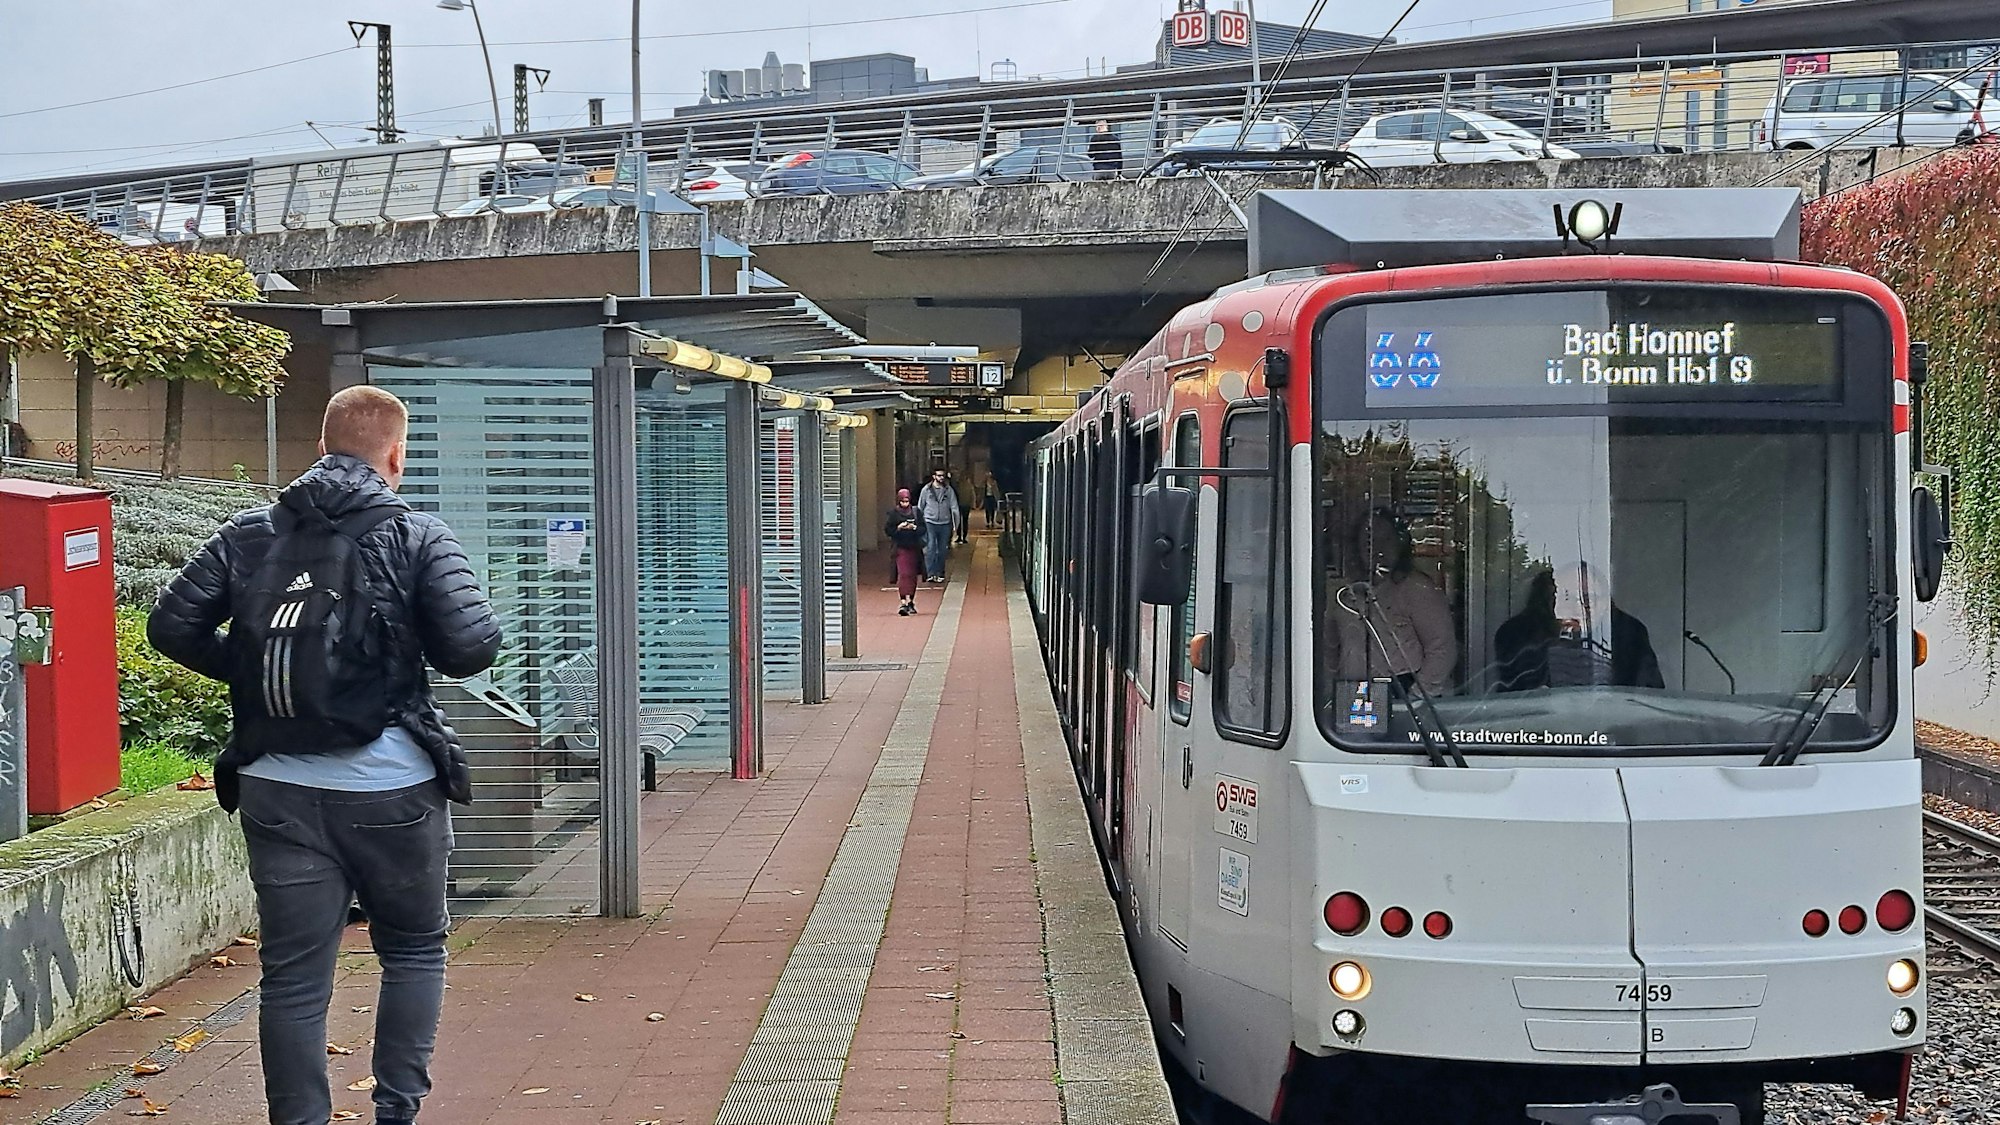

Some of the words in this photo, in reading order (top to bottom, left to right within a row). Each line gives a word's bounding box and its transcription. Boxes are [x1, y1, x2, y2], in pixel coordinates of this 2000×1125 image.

[1177, 16, 1203, 40] DB
[1223, 16, 1245, 40] DB
[1563, 323, 1620, 355] Bad
[1628, 323, 1735, 355] Honnef
[1370, 332, 1440, 388] 66
[1546, 359, 1572, 384] ü.
[1582, 357, 1657, 384] Bonn
[1667, 356, 1718, 384] Hbf
[985, 373, 998, 383] 12
[286, 581, 314, 592] adidas
[1230, 784, 1256, 807] SWB
[1230, 819, 1248, 839] 7459
[1652, 1028, 1664, 1042] B
